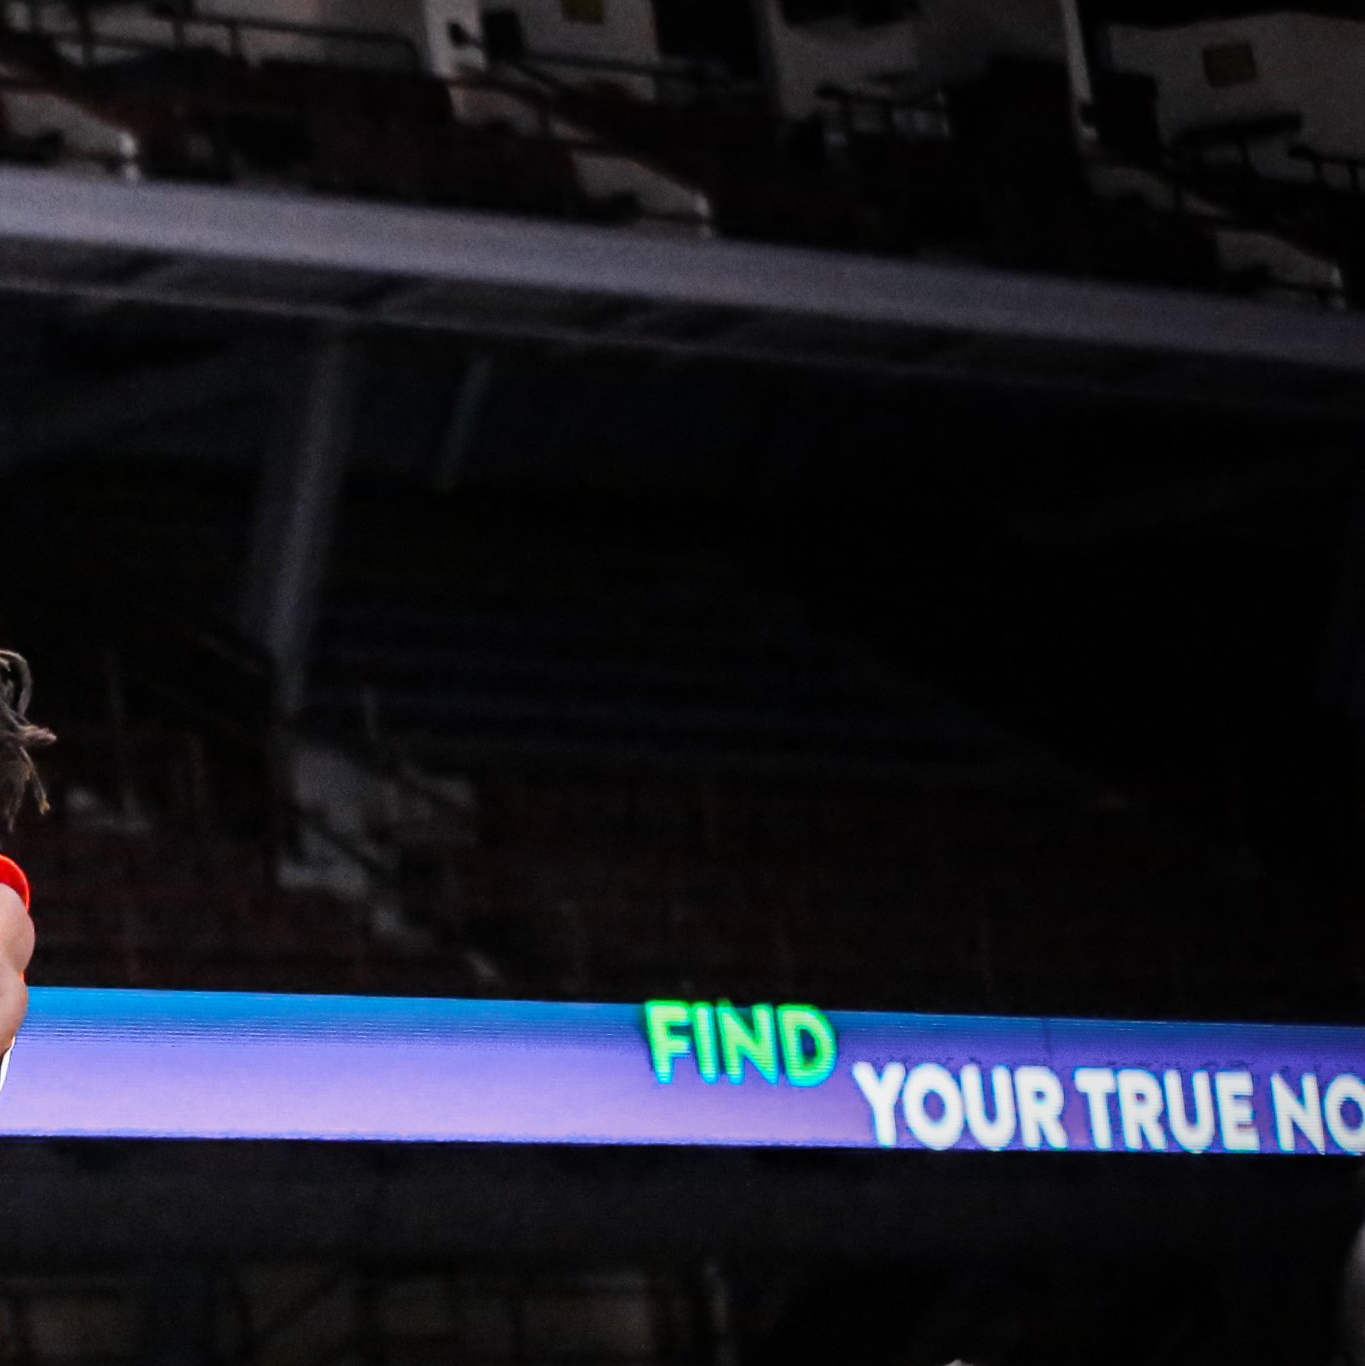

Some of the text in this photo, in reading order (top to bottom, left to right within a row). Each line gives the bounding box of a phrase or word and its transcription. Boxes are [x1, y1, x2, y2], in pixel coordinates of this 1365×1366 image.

[645, 999, 837, 1088] FIND
[852, 1061, 1068, 1151] YOUR
[1075, 1066, 1260, 1154] TRUE
